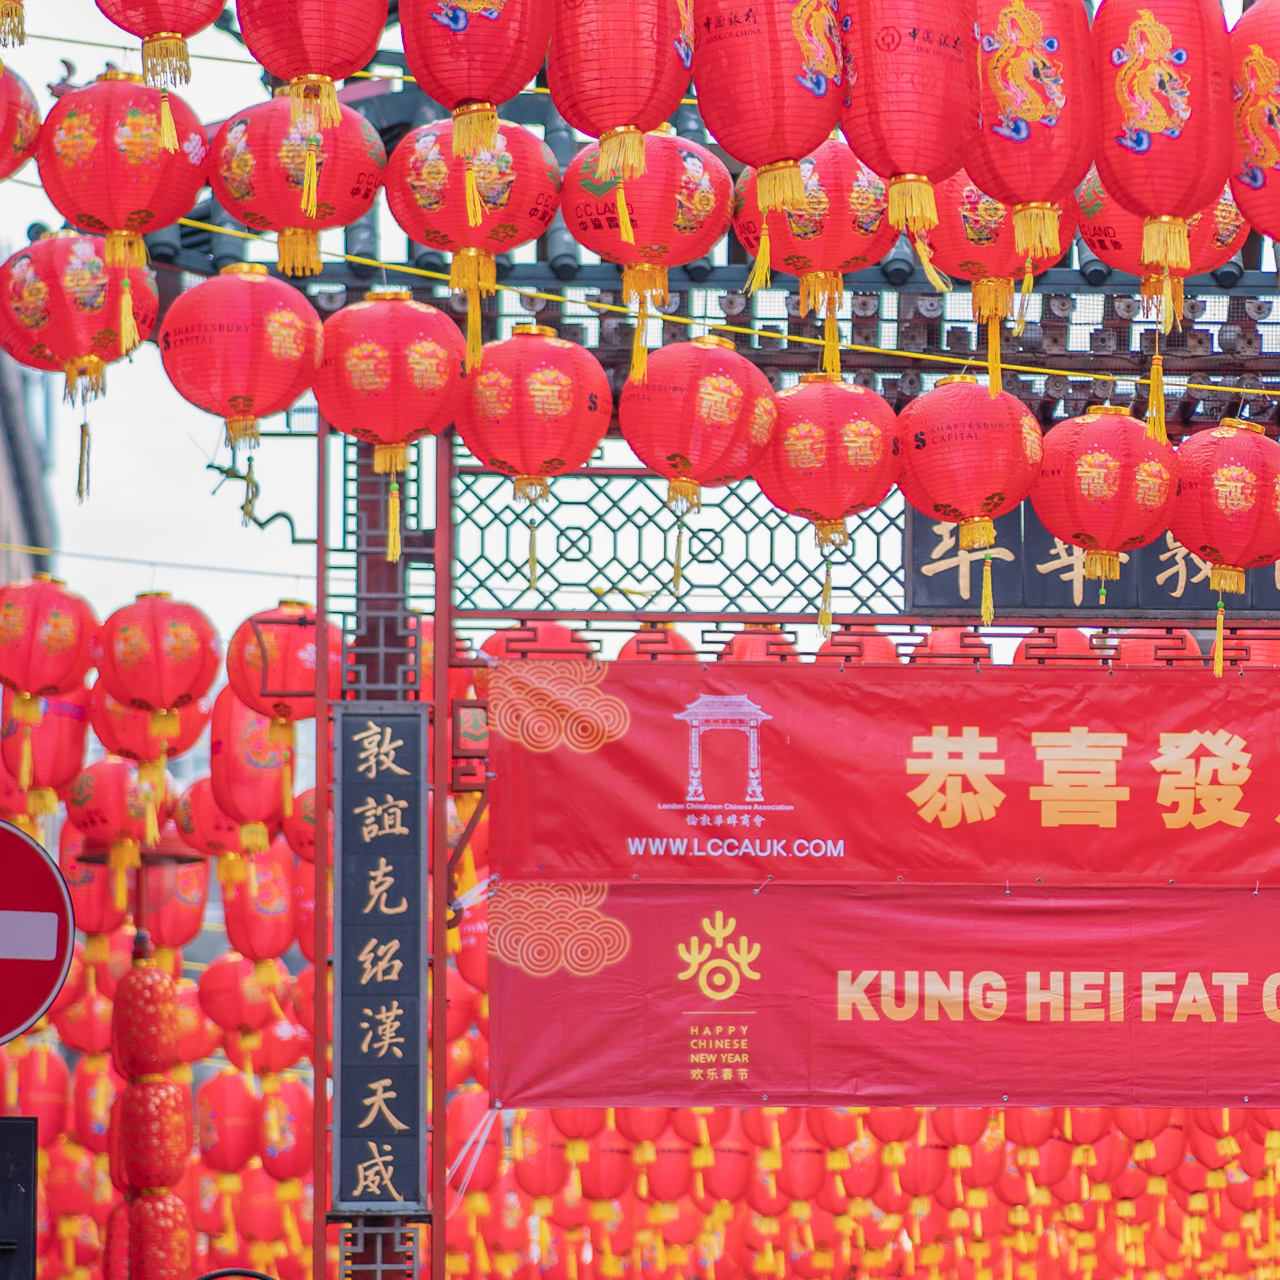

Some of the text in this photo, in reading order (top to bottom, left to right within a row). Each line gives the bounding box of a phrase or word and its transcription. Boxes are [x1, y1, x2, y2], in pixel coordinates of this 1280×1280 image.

[172, 334, 215, 347] CAPITAL
[930, 421, 1012, 434] SHAFTESBURY
[931, 431, 981, 445] CAPITAL
[658, 802, 794, 812] London Chinatown Chinese Association
[627, 837, 845, 858] WWW.LCCAUK.COM
[837, 970, 1008, 1022] KUNG
[1026, 970, 1125, 1022] HEI
[1141, 971, 1249, 1023] FAT
[690, 1025, 749, 1036] HAPPY
[690, 1039, 749, 1049] CHINESE
[690, 1053, 750, 1063] NEW YEAR
[690, 1067, 750, 1081] 欢乐春节
